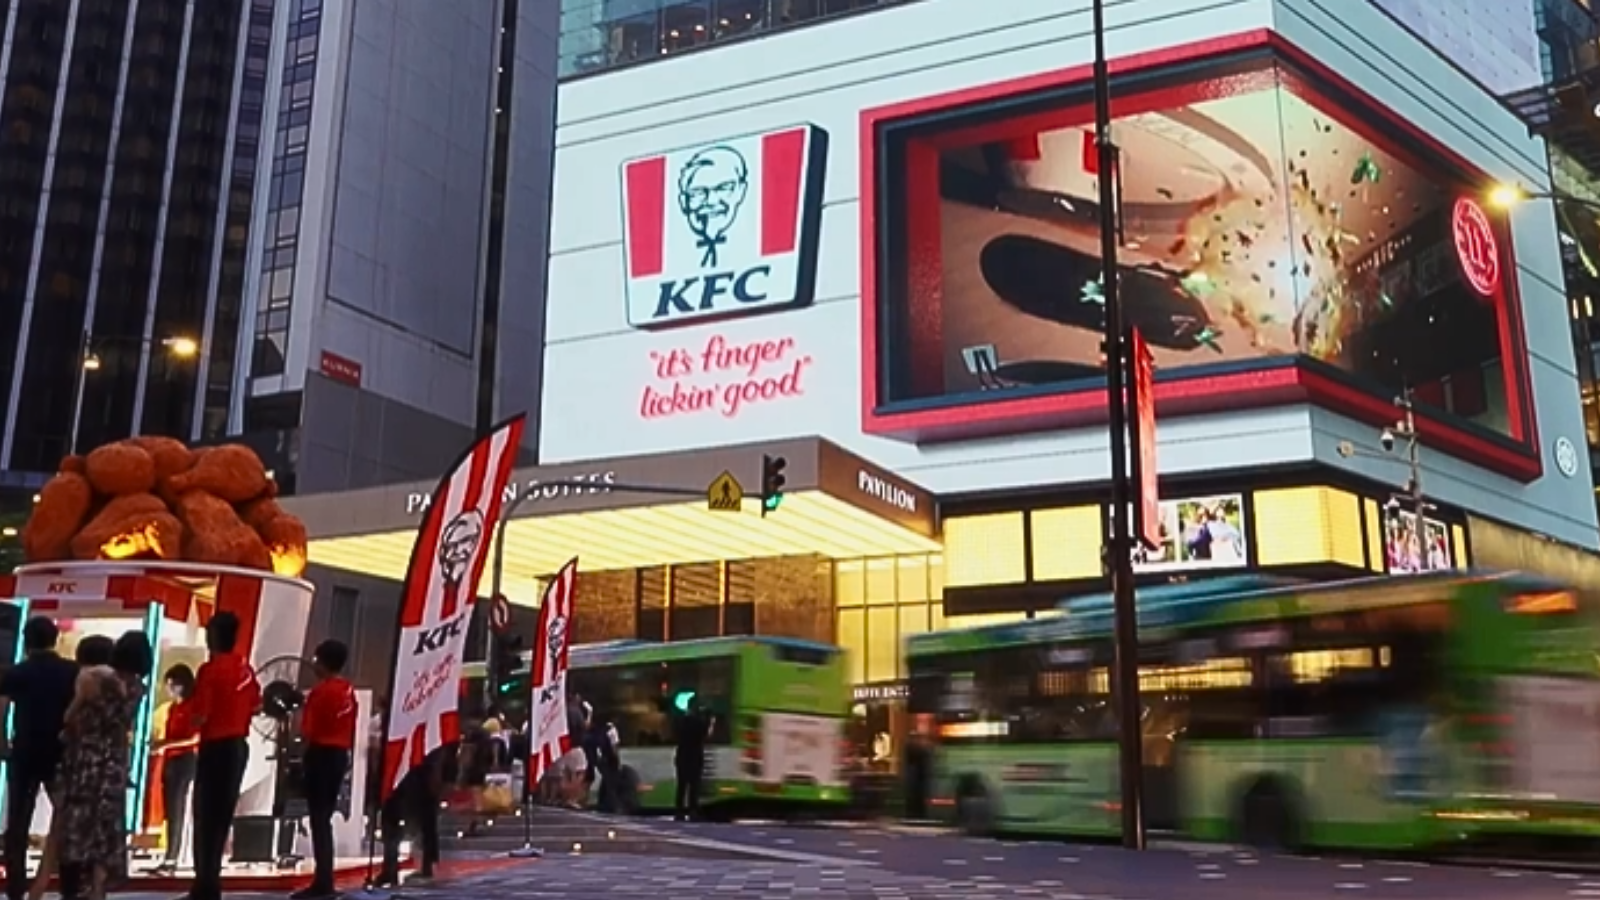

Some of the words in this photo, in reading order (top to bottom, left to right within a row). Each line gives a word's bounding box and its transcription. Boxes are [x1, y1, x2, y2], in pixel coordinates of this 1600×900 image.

[652, 265, 770, 318] KFC
[701, 334, 794, 376] finger
[640, 382, 720, 418] lickin'
[858, 469, 916, 513] PAVILION
[413, 612, 465, 656] KFC
